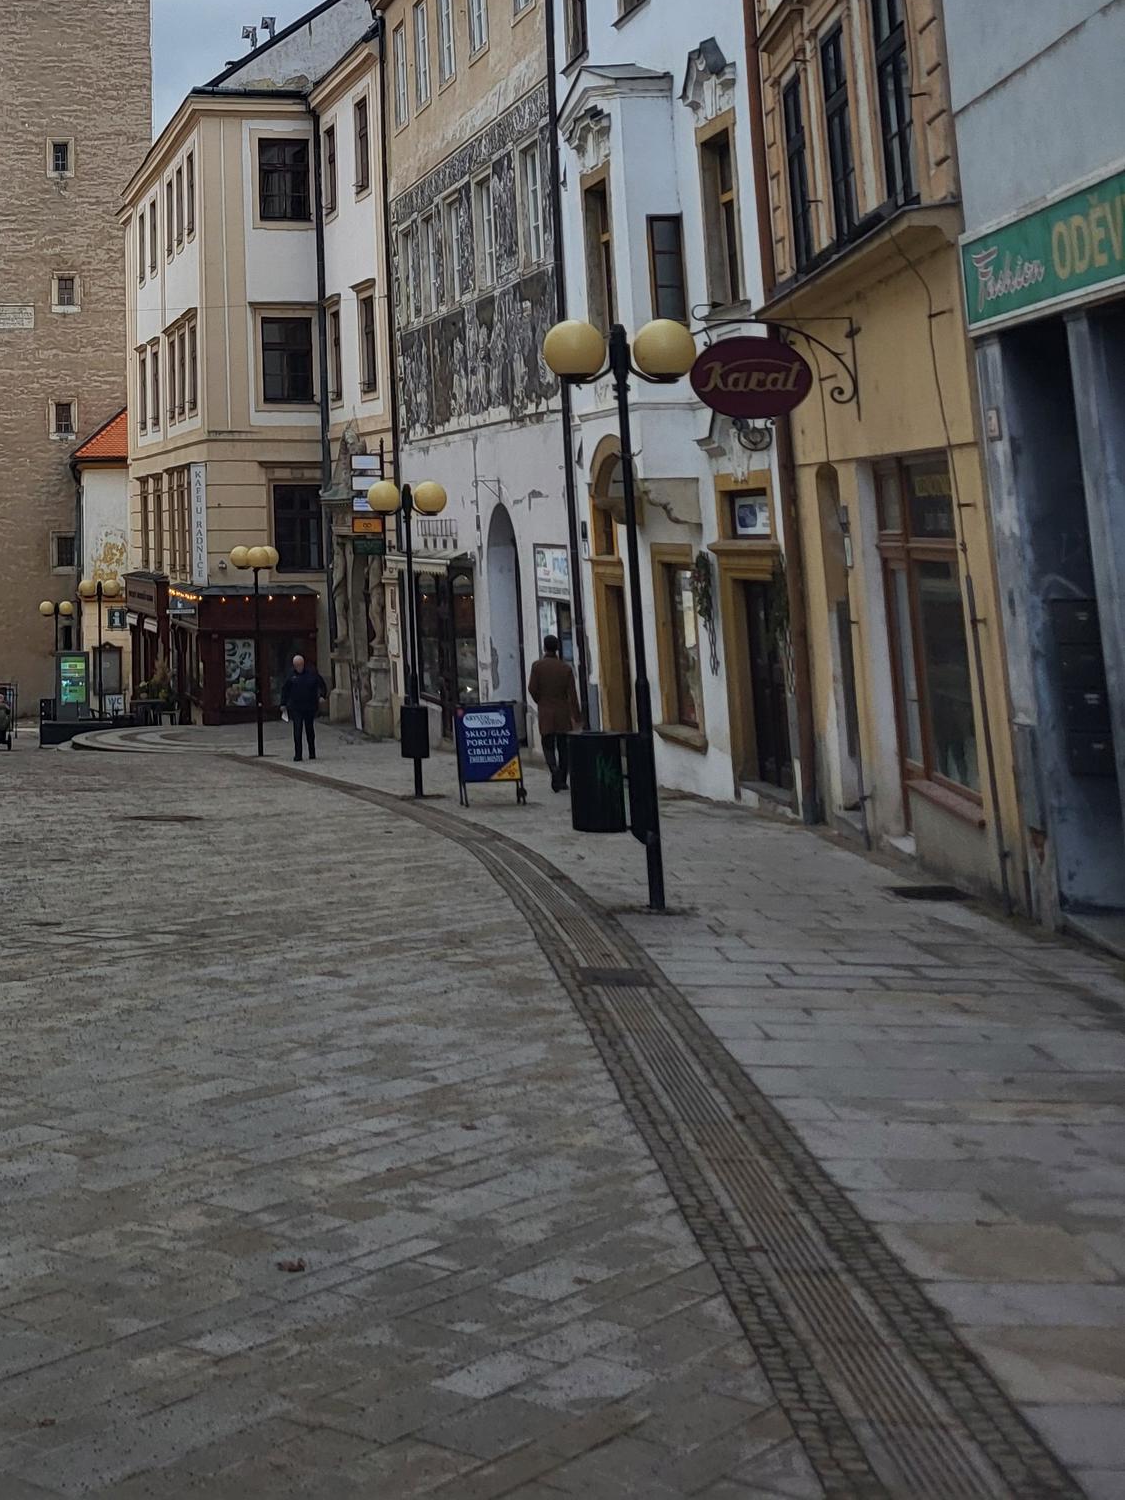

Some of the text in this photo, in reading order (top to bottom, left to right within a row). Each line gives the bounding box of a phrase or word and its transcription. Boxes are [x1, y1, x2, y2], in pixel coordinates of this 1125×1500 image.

[971, 192, 1125, 312] Fashion ODĚV
[699, 359, 801, 392] Karat
[196, 521, 204, 578] RADNICE
[107, 697, 122, 705] WC
